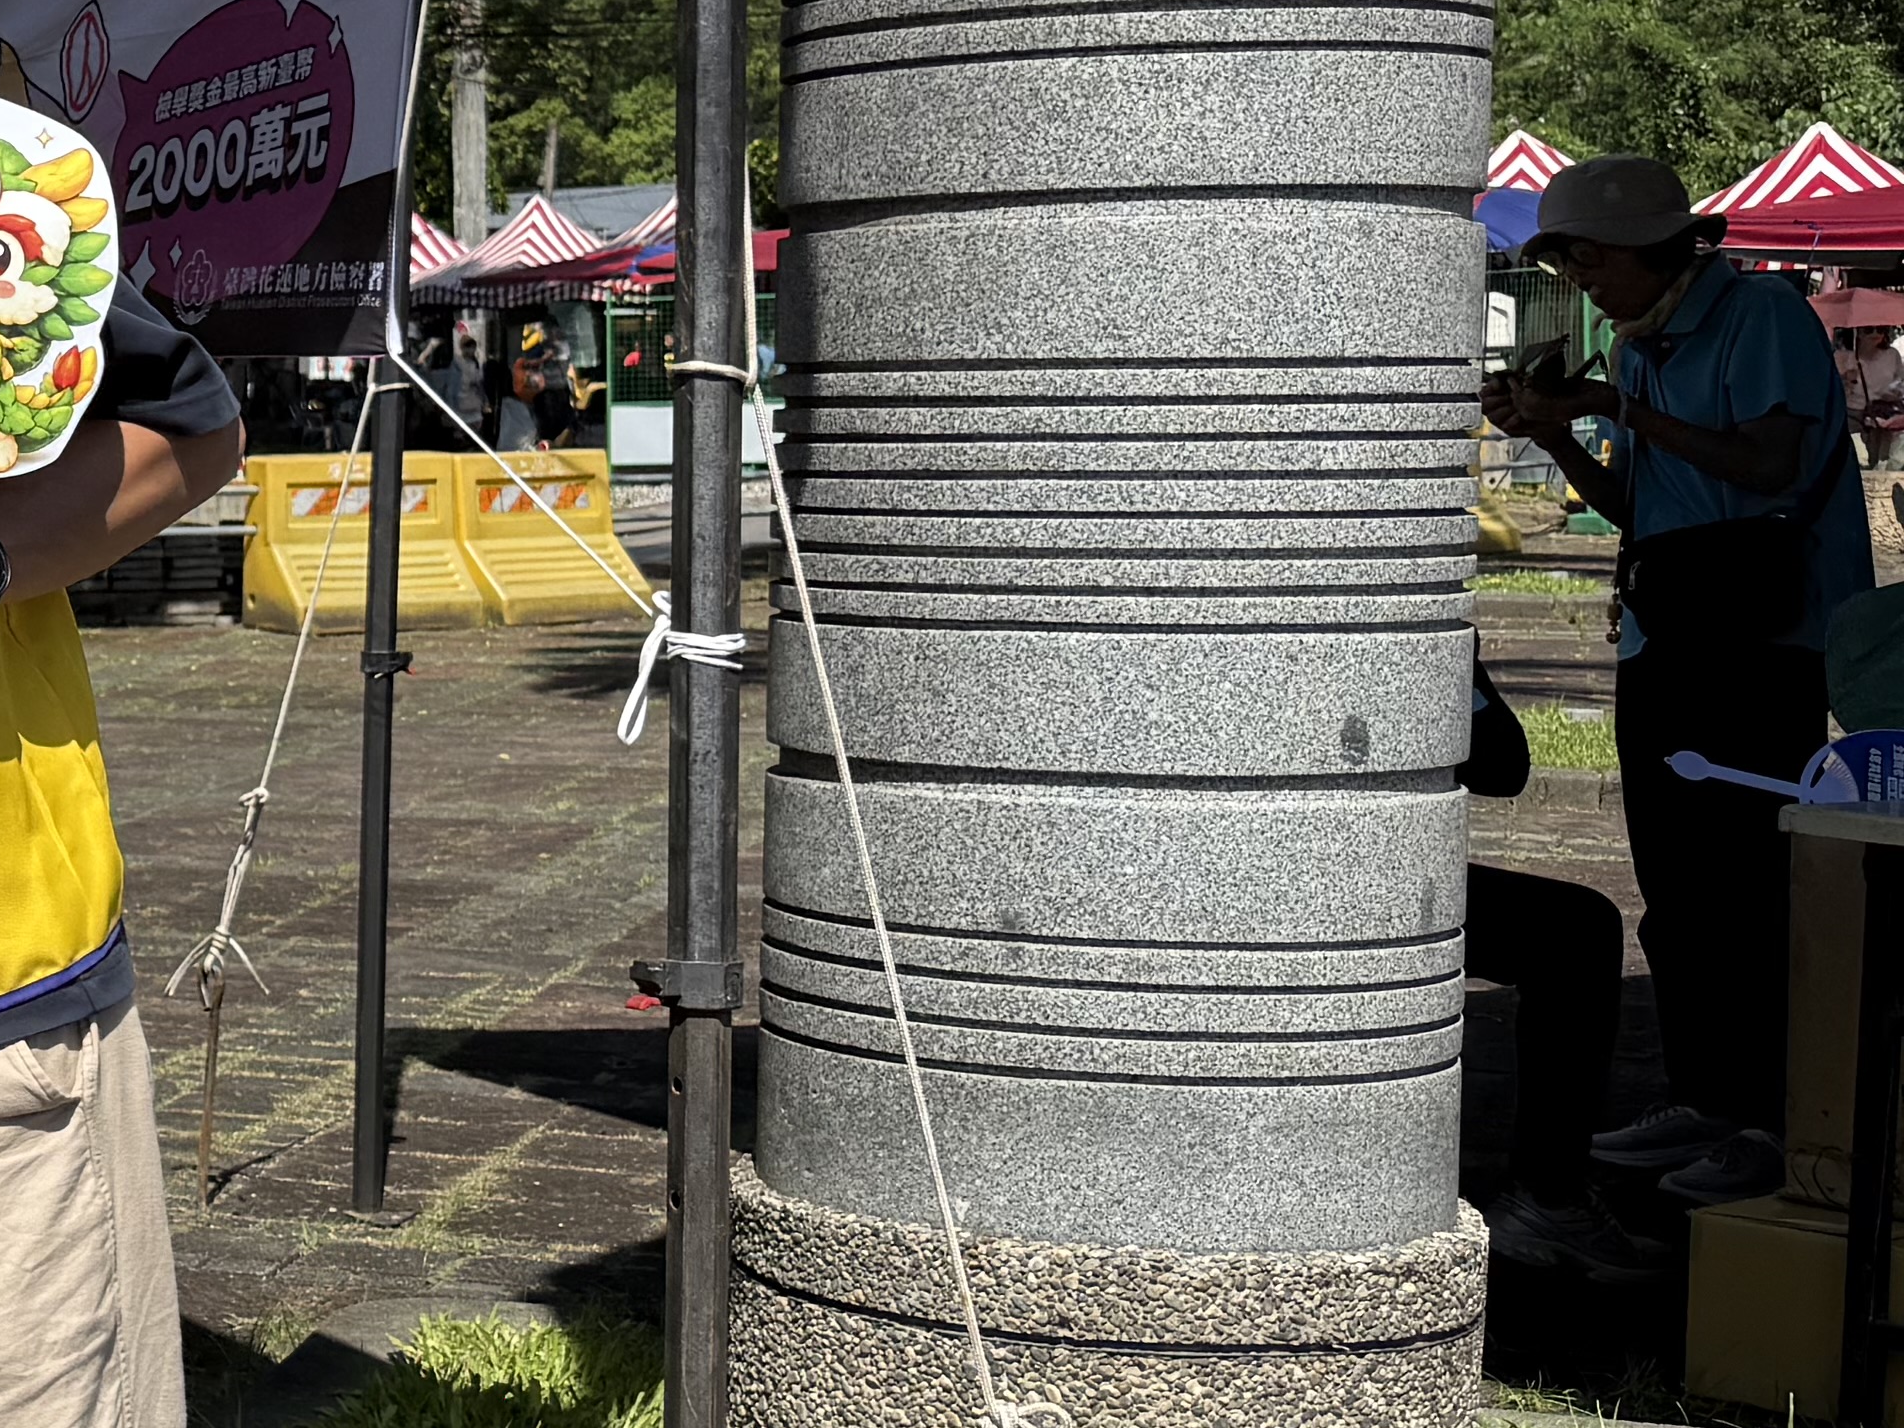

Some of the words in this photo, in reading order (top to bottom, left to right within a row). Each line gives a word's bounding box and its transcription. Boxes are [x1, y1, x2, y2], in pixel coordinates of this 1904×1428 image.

[154, 46, 316, 122] 檢舉獎金最高新臺幣
[124, 92, 332, 214] 2000萬元
